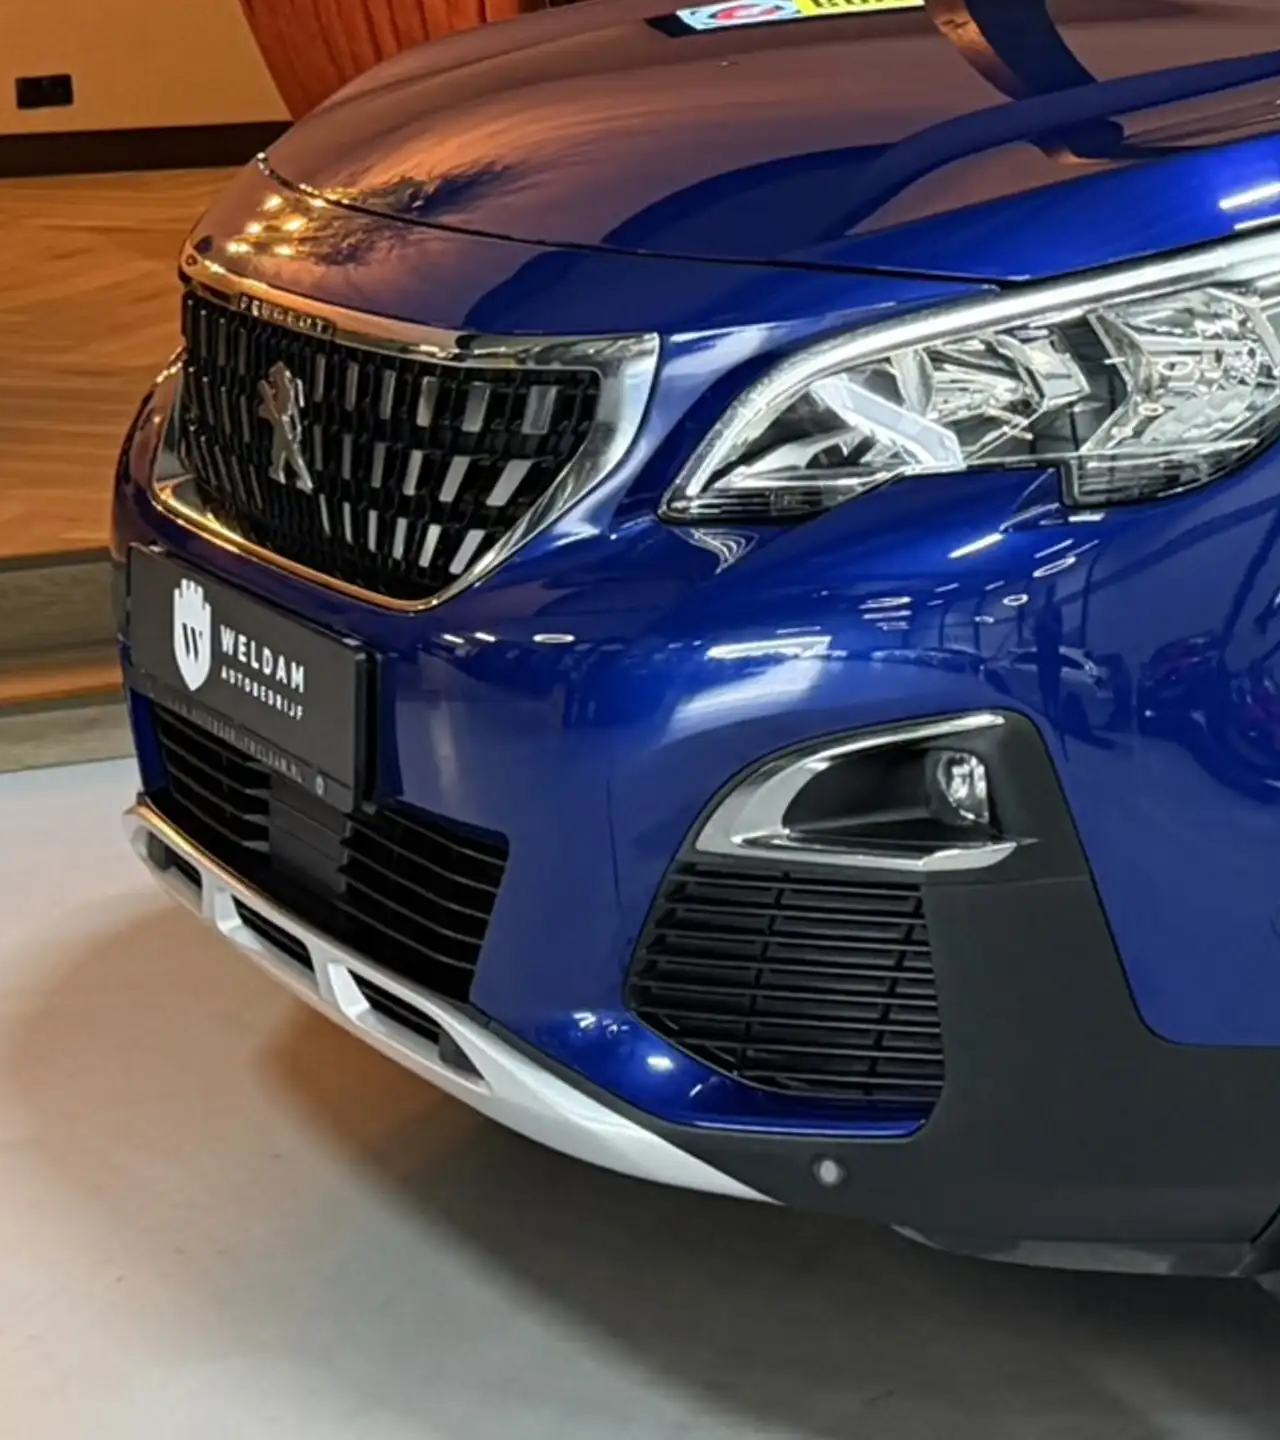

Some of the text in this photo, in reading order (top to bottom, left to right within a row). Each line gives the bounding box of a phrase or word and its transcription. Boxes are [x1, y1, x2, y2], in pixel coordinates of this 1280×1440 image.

[239, 296, 325, 333] PEUGEOT
[219, 623, 305, 694] WELDAM
[220, 664, 304, 721] AUTOBEDRIJF
